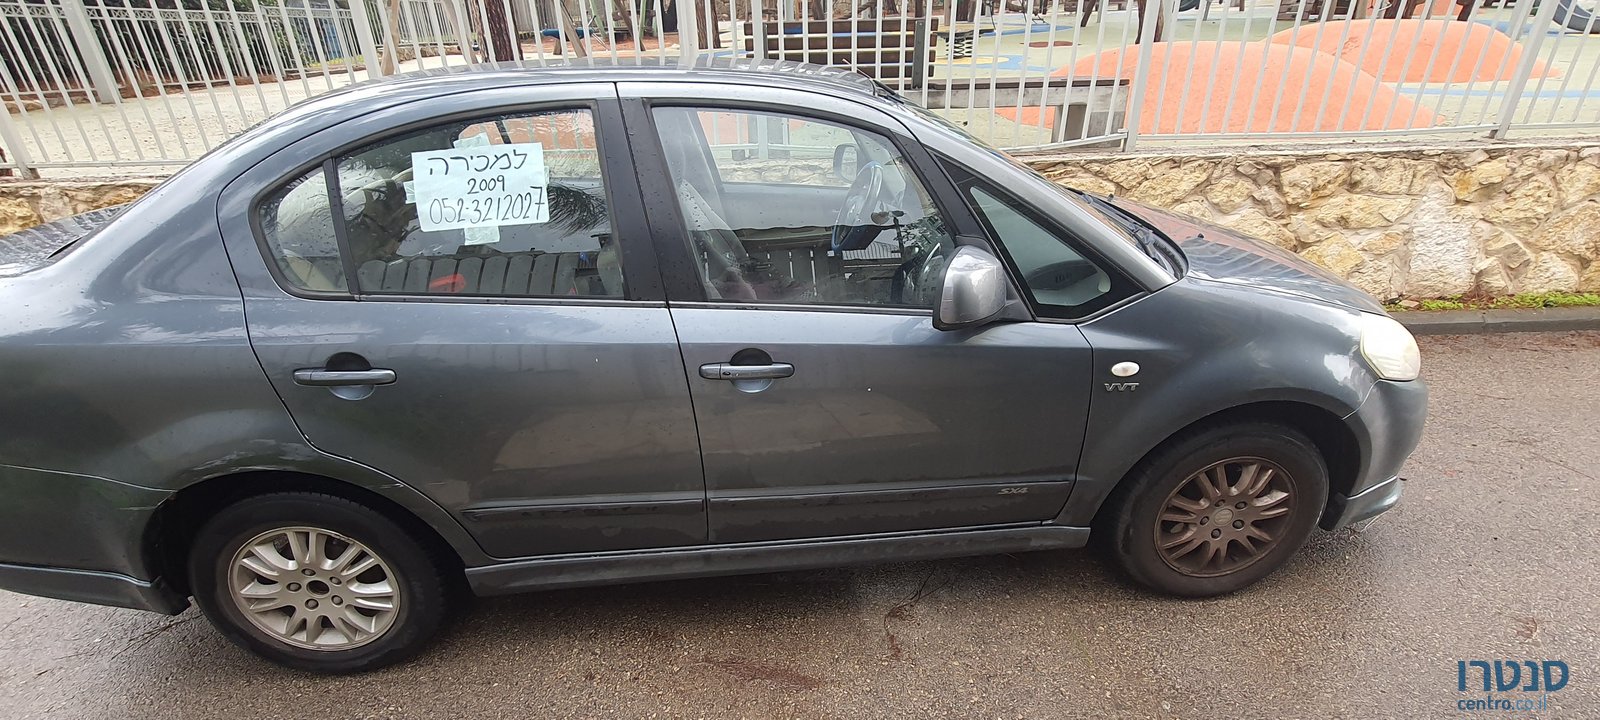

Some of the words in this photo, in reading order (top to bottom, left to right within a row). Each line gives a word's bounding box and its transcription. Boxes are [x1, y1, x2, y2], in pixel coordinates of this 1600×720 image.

[427, 149, 528, 175] למכירה
[467, 174, 505, 195] 2009
[429, 185, 545, 225] 052-3212027
[1104, 382, 1140, 392] VVT
